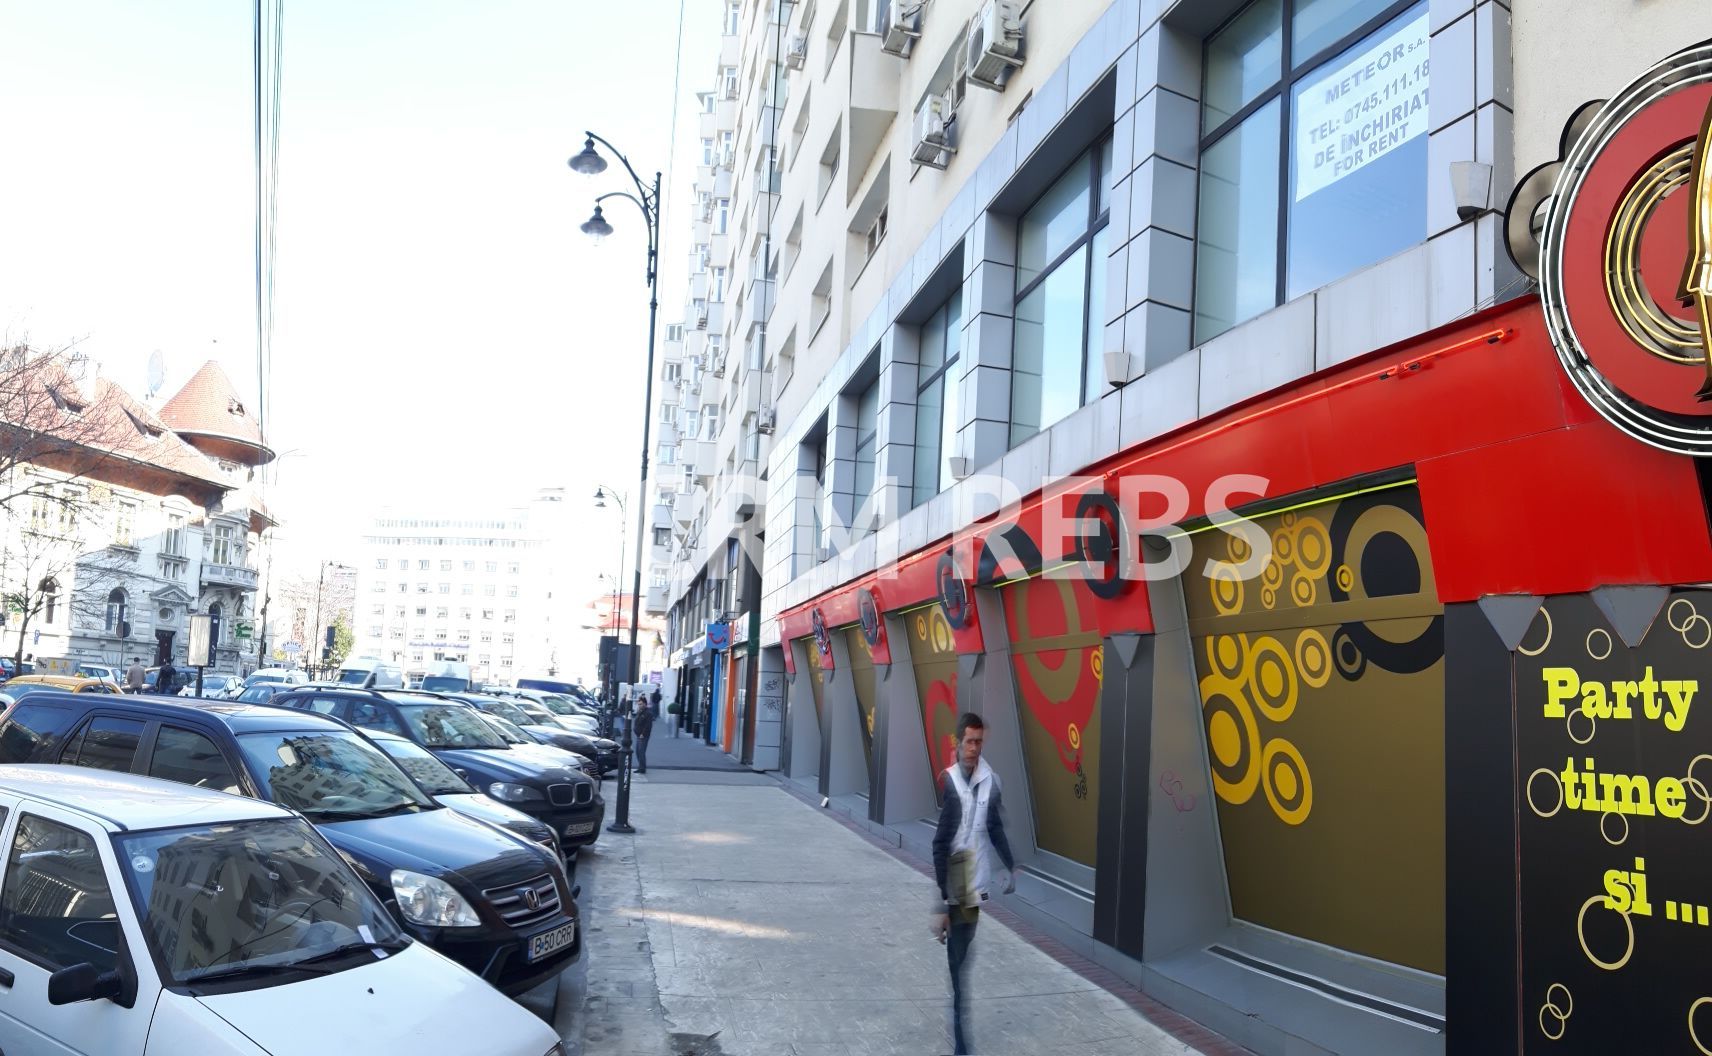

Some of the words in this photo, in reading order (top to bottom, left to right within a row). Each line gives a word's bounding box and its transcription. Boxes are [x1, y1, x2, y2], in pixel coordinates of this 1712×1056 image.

[1324, 43, 1405, 105] METEOR
[1408, 38, 1426, 53] S.A.
[1309, 119, 1341, 145] TEL:
[1313, 144, 1336, 169] DE
[1334, 149, 1364, 177] FOR
[1368, 122, 1409, 158] RENT
[1542, 666, 1698, 731] Party
[1560, 756, 1687, 819] time
[1603, 856, 1653, 916] si
[534, 937, 541, 955] B
[544, 932, 555, 951] 50
[556, 925, 573, 946] CRR
